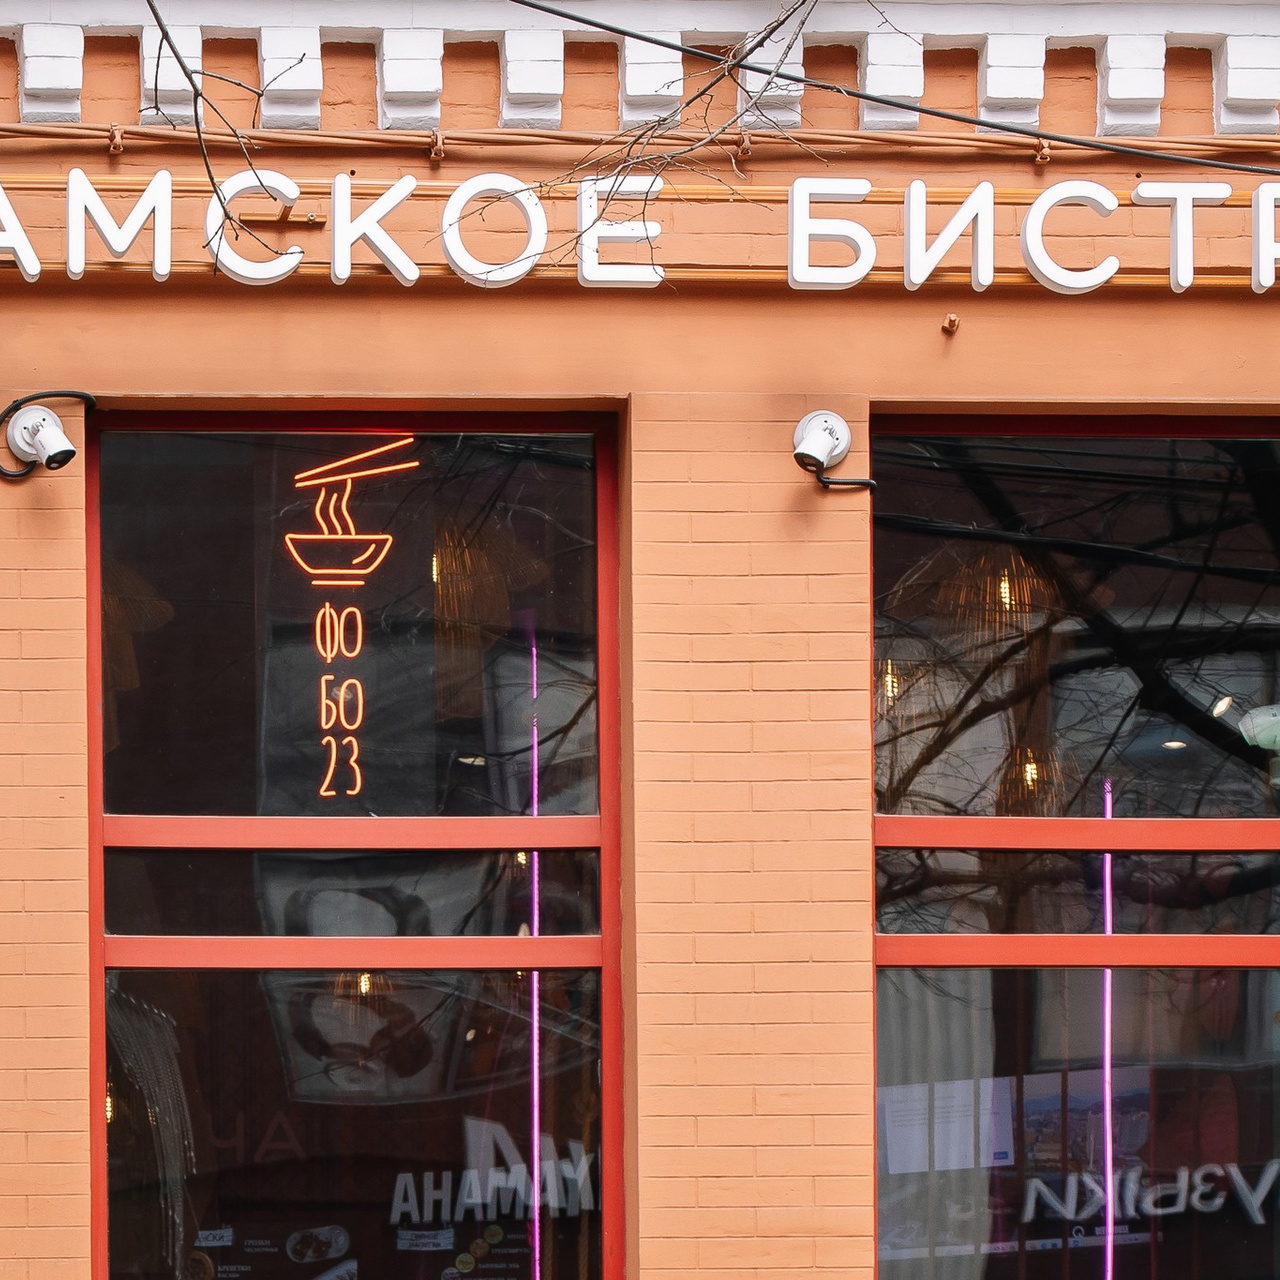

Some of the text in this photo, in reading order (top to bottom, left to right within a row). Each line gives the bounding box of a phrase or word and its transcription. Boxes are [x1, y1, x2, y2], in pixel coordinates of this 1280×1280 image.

[314, 601, 364, 664] ФО
[319, 674, 365, 731] БО
[318, 735, 363, 797] 23
